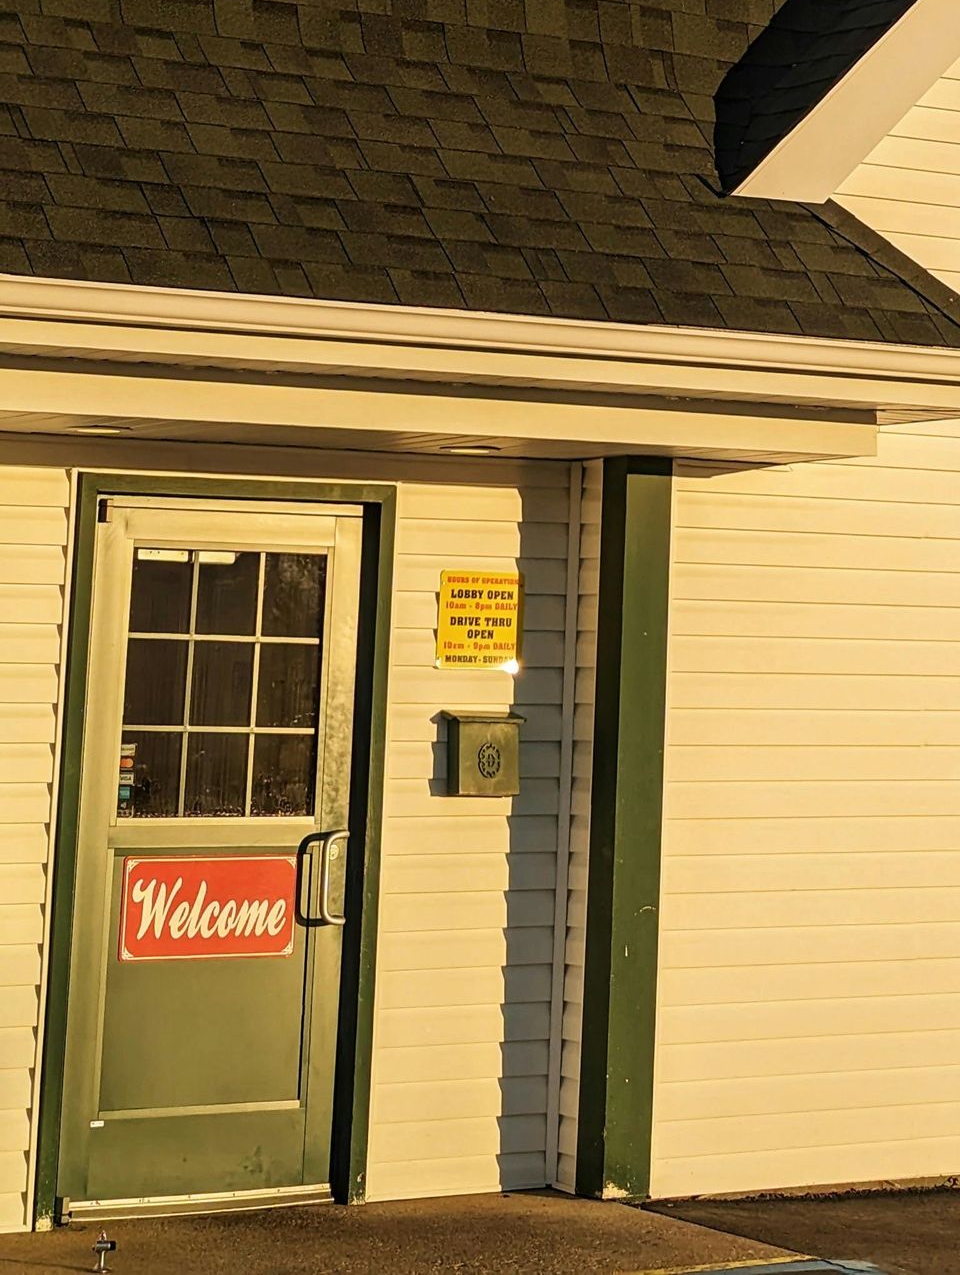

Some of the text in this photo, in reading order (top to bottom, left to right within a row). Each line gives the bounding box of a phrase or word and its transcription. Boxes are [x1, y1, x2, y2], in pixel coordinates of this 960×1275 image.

[451, 589, 514, 600] LOBBY OPEN
[446, 601, 467, 609] 10am
[495, 603, 517, 611] DAILY
[450, 616, 512, 627] DRIVE THRU
[467, 629, 494, 639] OPEN
[493, 642, 516, 650] DAILY
[132, 877, 286, 940] Welcome
